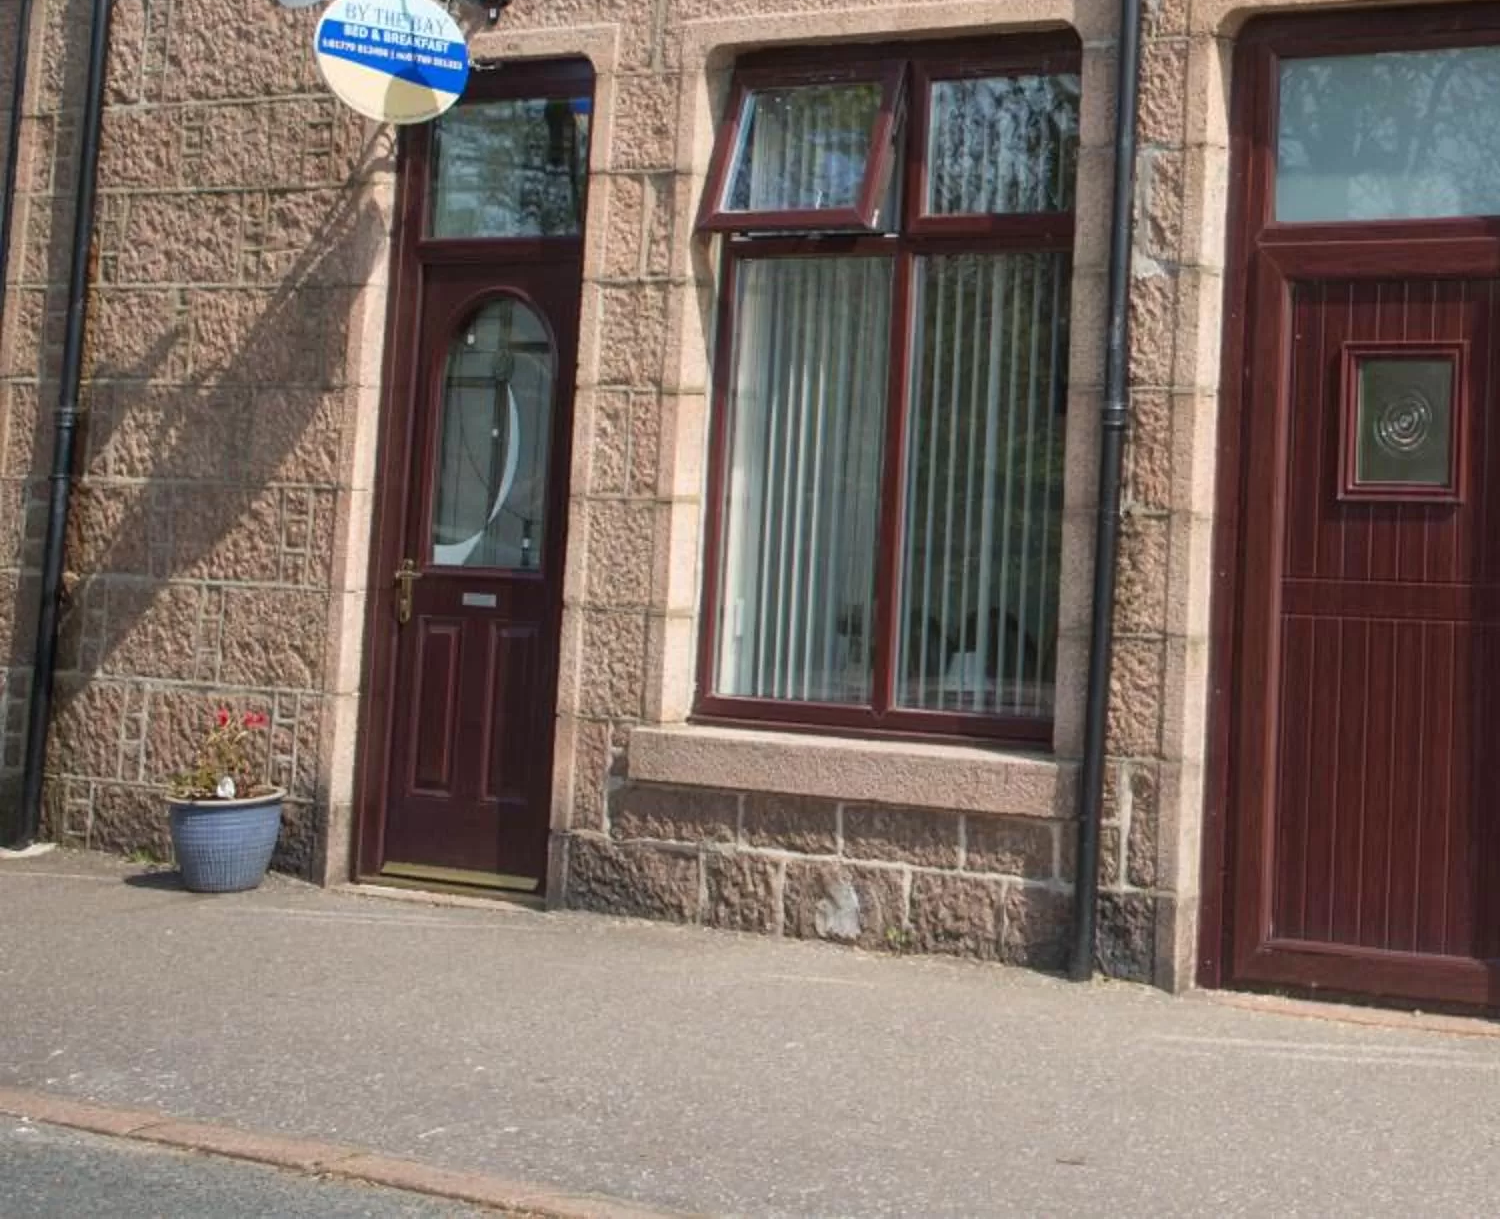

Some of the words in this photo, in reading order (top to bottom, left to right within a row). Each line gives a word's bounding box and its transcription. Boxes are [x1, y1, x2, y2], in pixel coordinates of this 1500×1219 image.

[345, 2, 370, 21] BY
[375, 7, 407, 28] THE
[410, 15, 449, 37] BAY
[344, 24, 368, 38] BED
[384, 30, 449, 53] BREAKFAST
